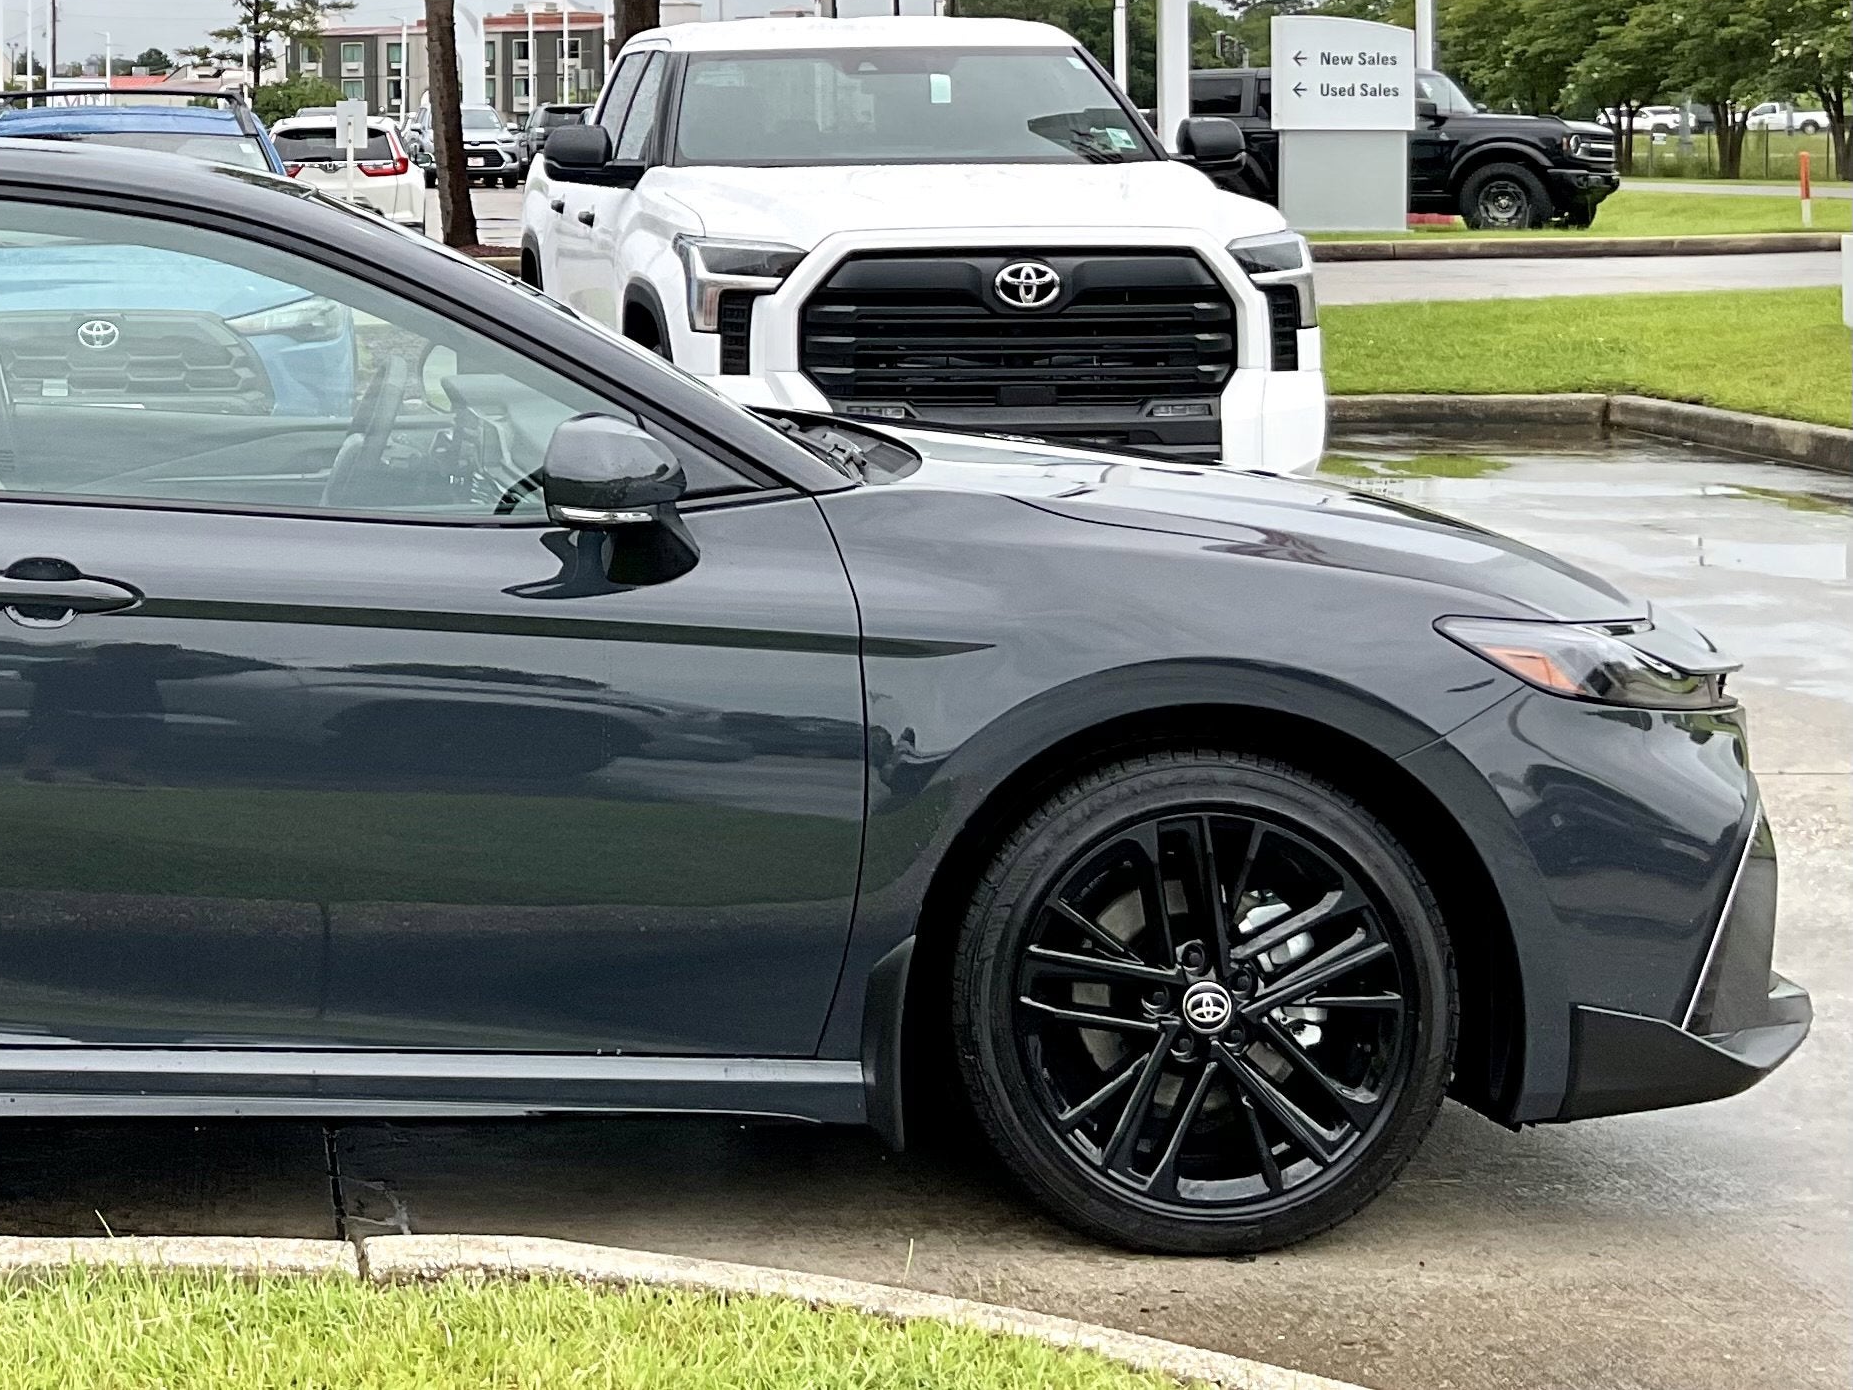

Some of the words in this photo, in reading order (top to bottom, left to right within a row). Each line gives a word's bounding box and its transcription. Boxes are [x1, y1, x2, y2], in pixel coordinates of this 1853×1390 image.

[1320, 52, 1353, 66] New
[1358, 52, 1398, 66] Sales
[1320, 83, 1355, 97] Used
[1359, 83, 1399, 97] Sales
